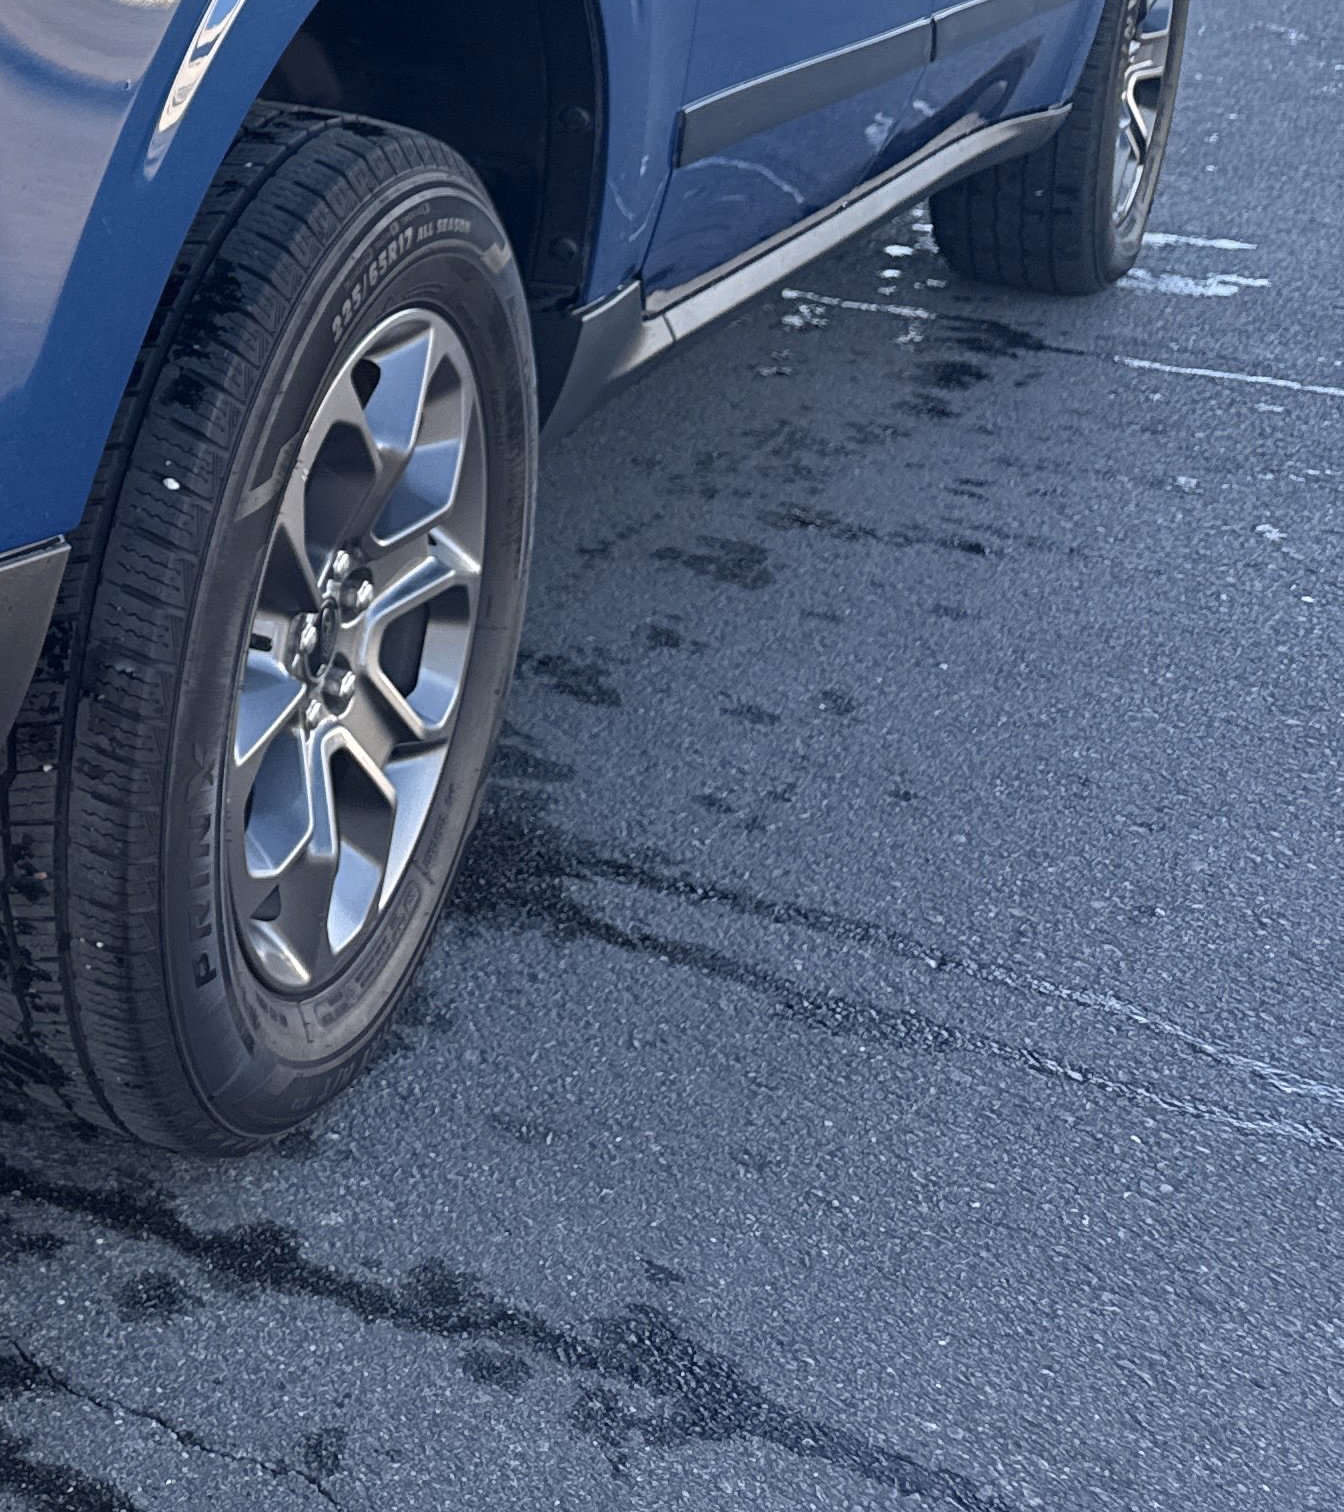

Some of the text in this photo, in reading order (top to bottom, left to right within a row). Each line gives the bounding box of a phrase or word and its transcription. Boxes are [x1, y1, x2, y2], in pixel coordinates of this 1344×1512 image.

[331, 217, 471, 343] 225/65R17 ALL SEASON
